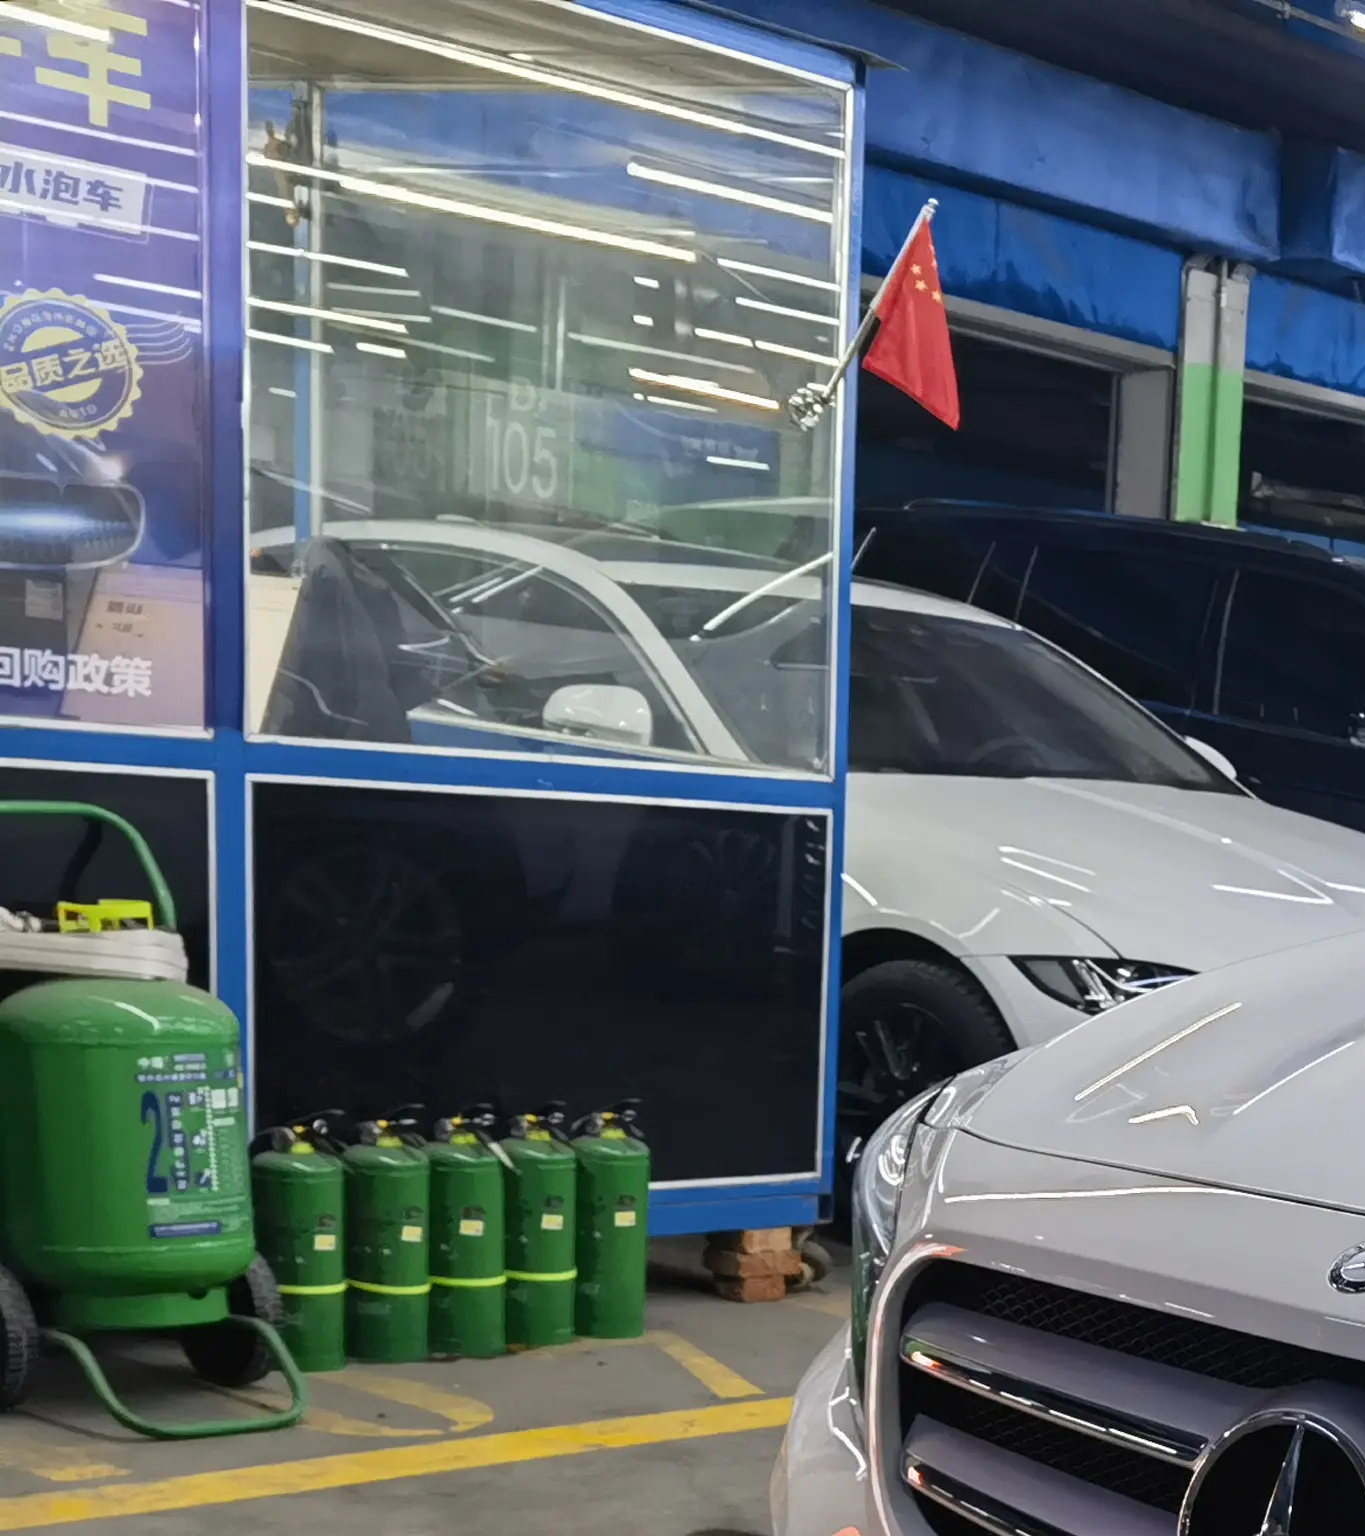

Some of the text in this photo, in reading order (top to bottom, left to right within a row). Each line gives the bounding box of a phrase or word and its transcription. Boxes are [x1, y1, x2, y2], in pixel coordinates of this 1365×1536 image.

[0, 0, 151, 128] 车
[0, 338, 131, 394] 品质之选
[0, 646, 153, 697] 回购政策
